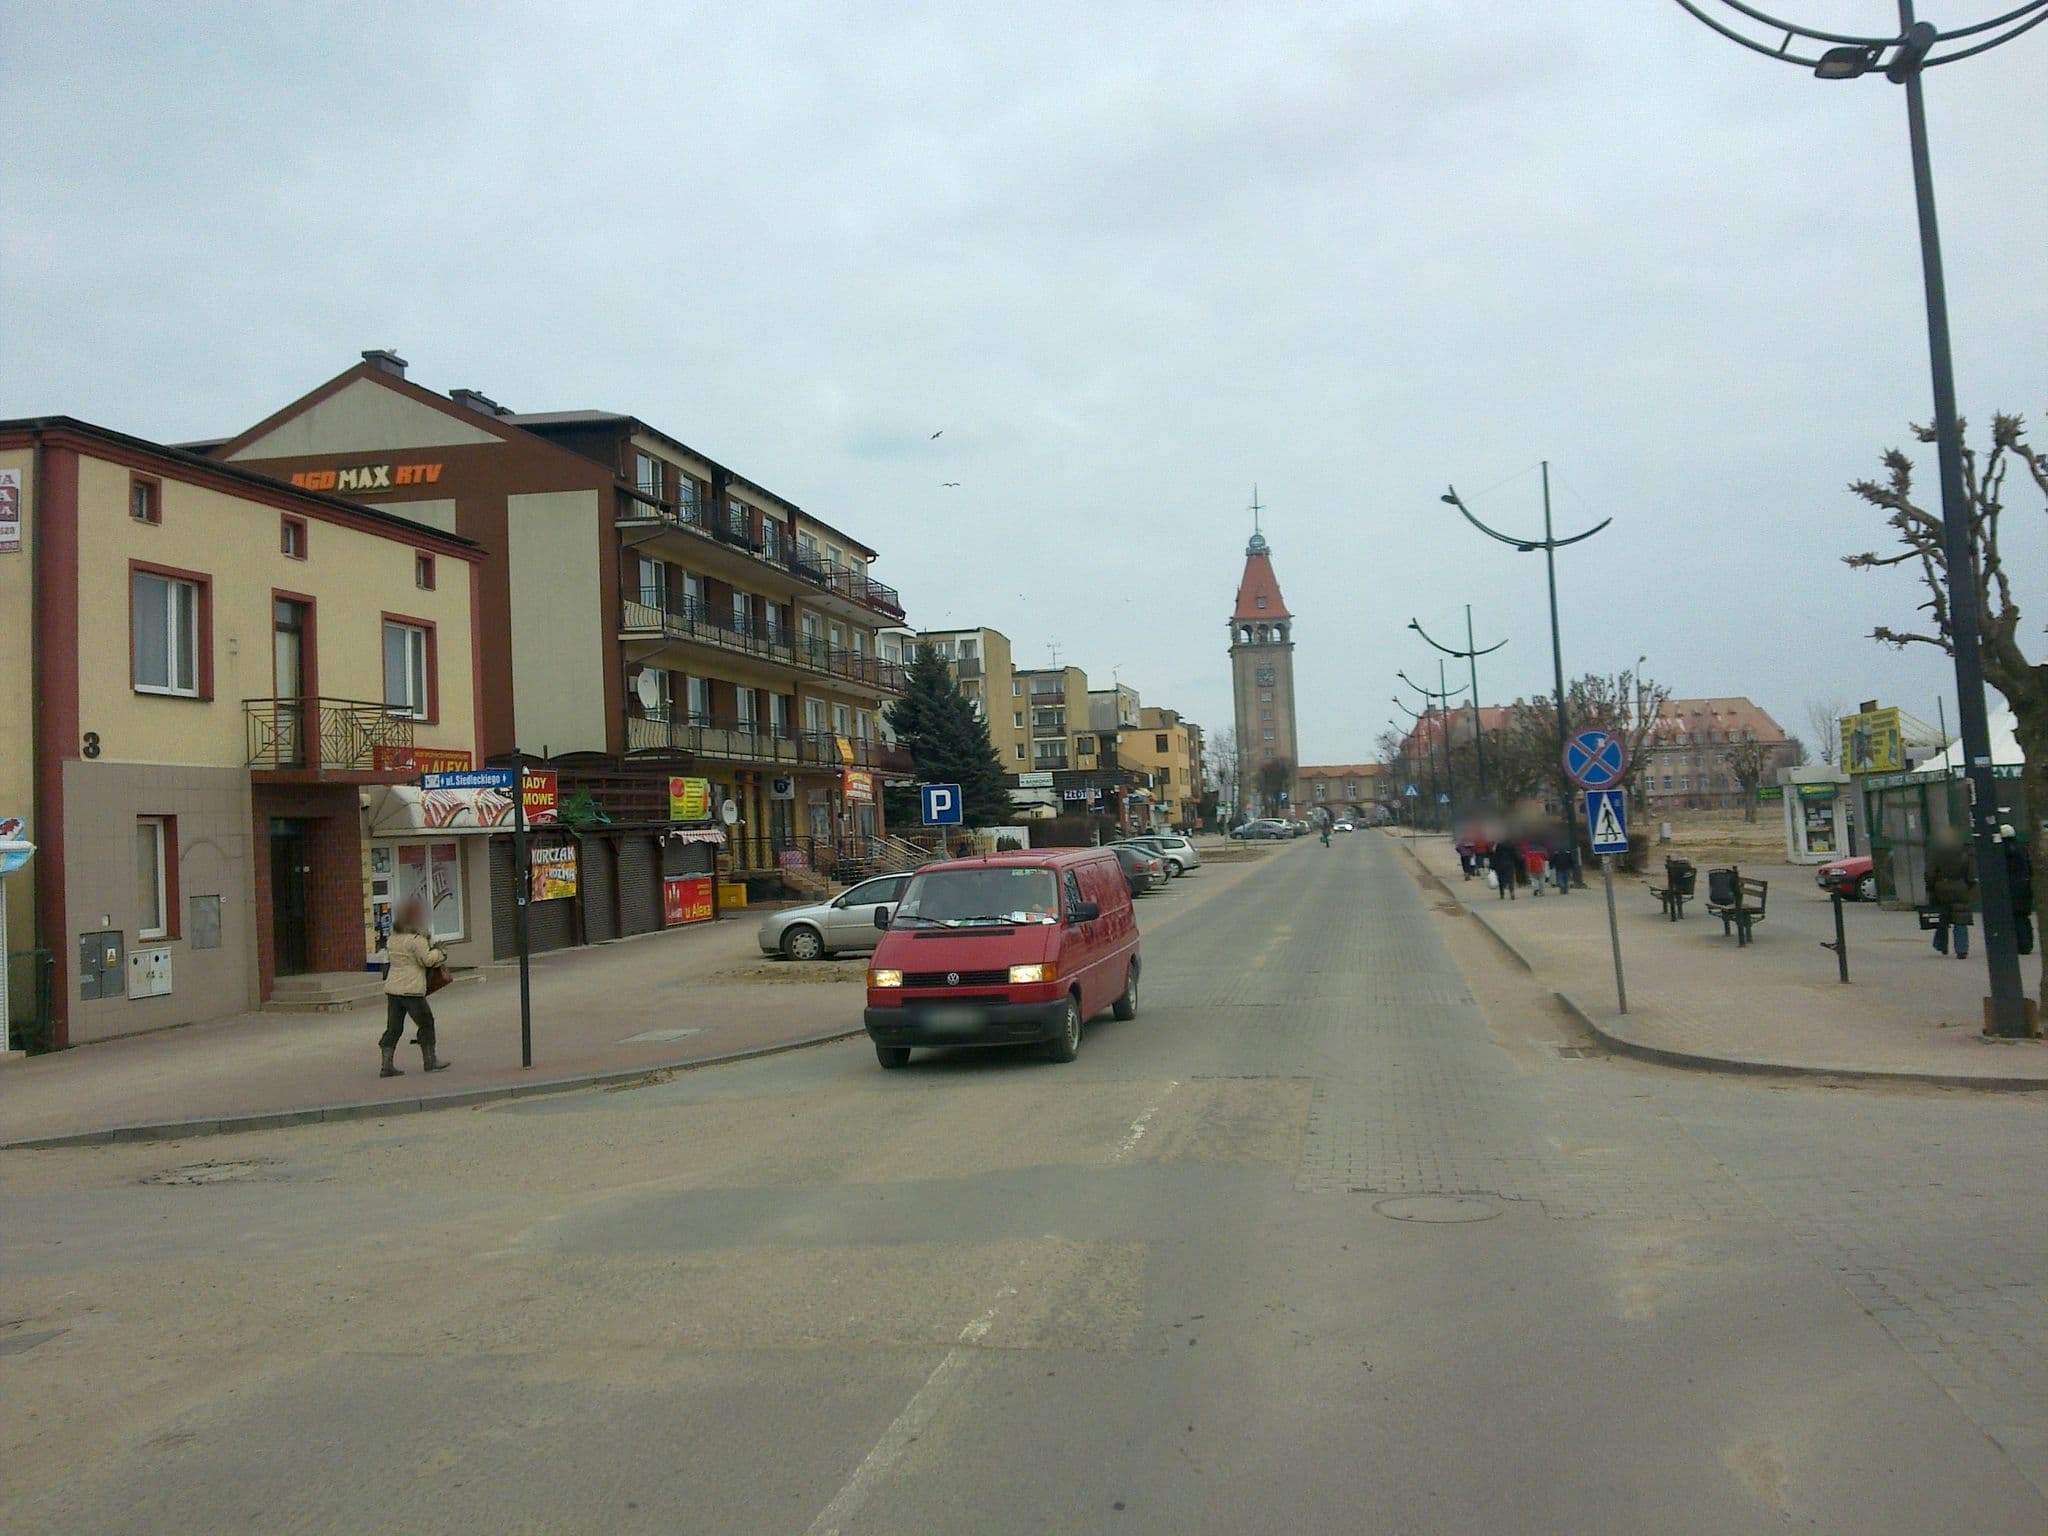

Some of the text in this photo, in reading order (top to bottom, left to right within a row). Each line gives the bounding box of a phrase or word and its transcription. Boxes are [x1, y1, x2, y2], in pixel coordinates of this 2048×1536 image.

[291, 464, 443, 491] AGD MAX RTV
[83, 732, 100, 758] 3
[455, 773, 501, 786] Siedleckiego
[522, 794, 554, 806] MOWE
[930, 789, 952, 820] P
[531, 846, 576, 865] KURCZAK
